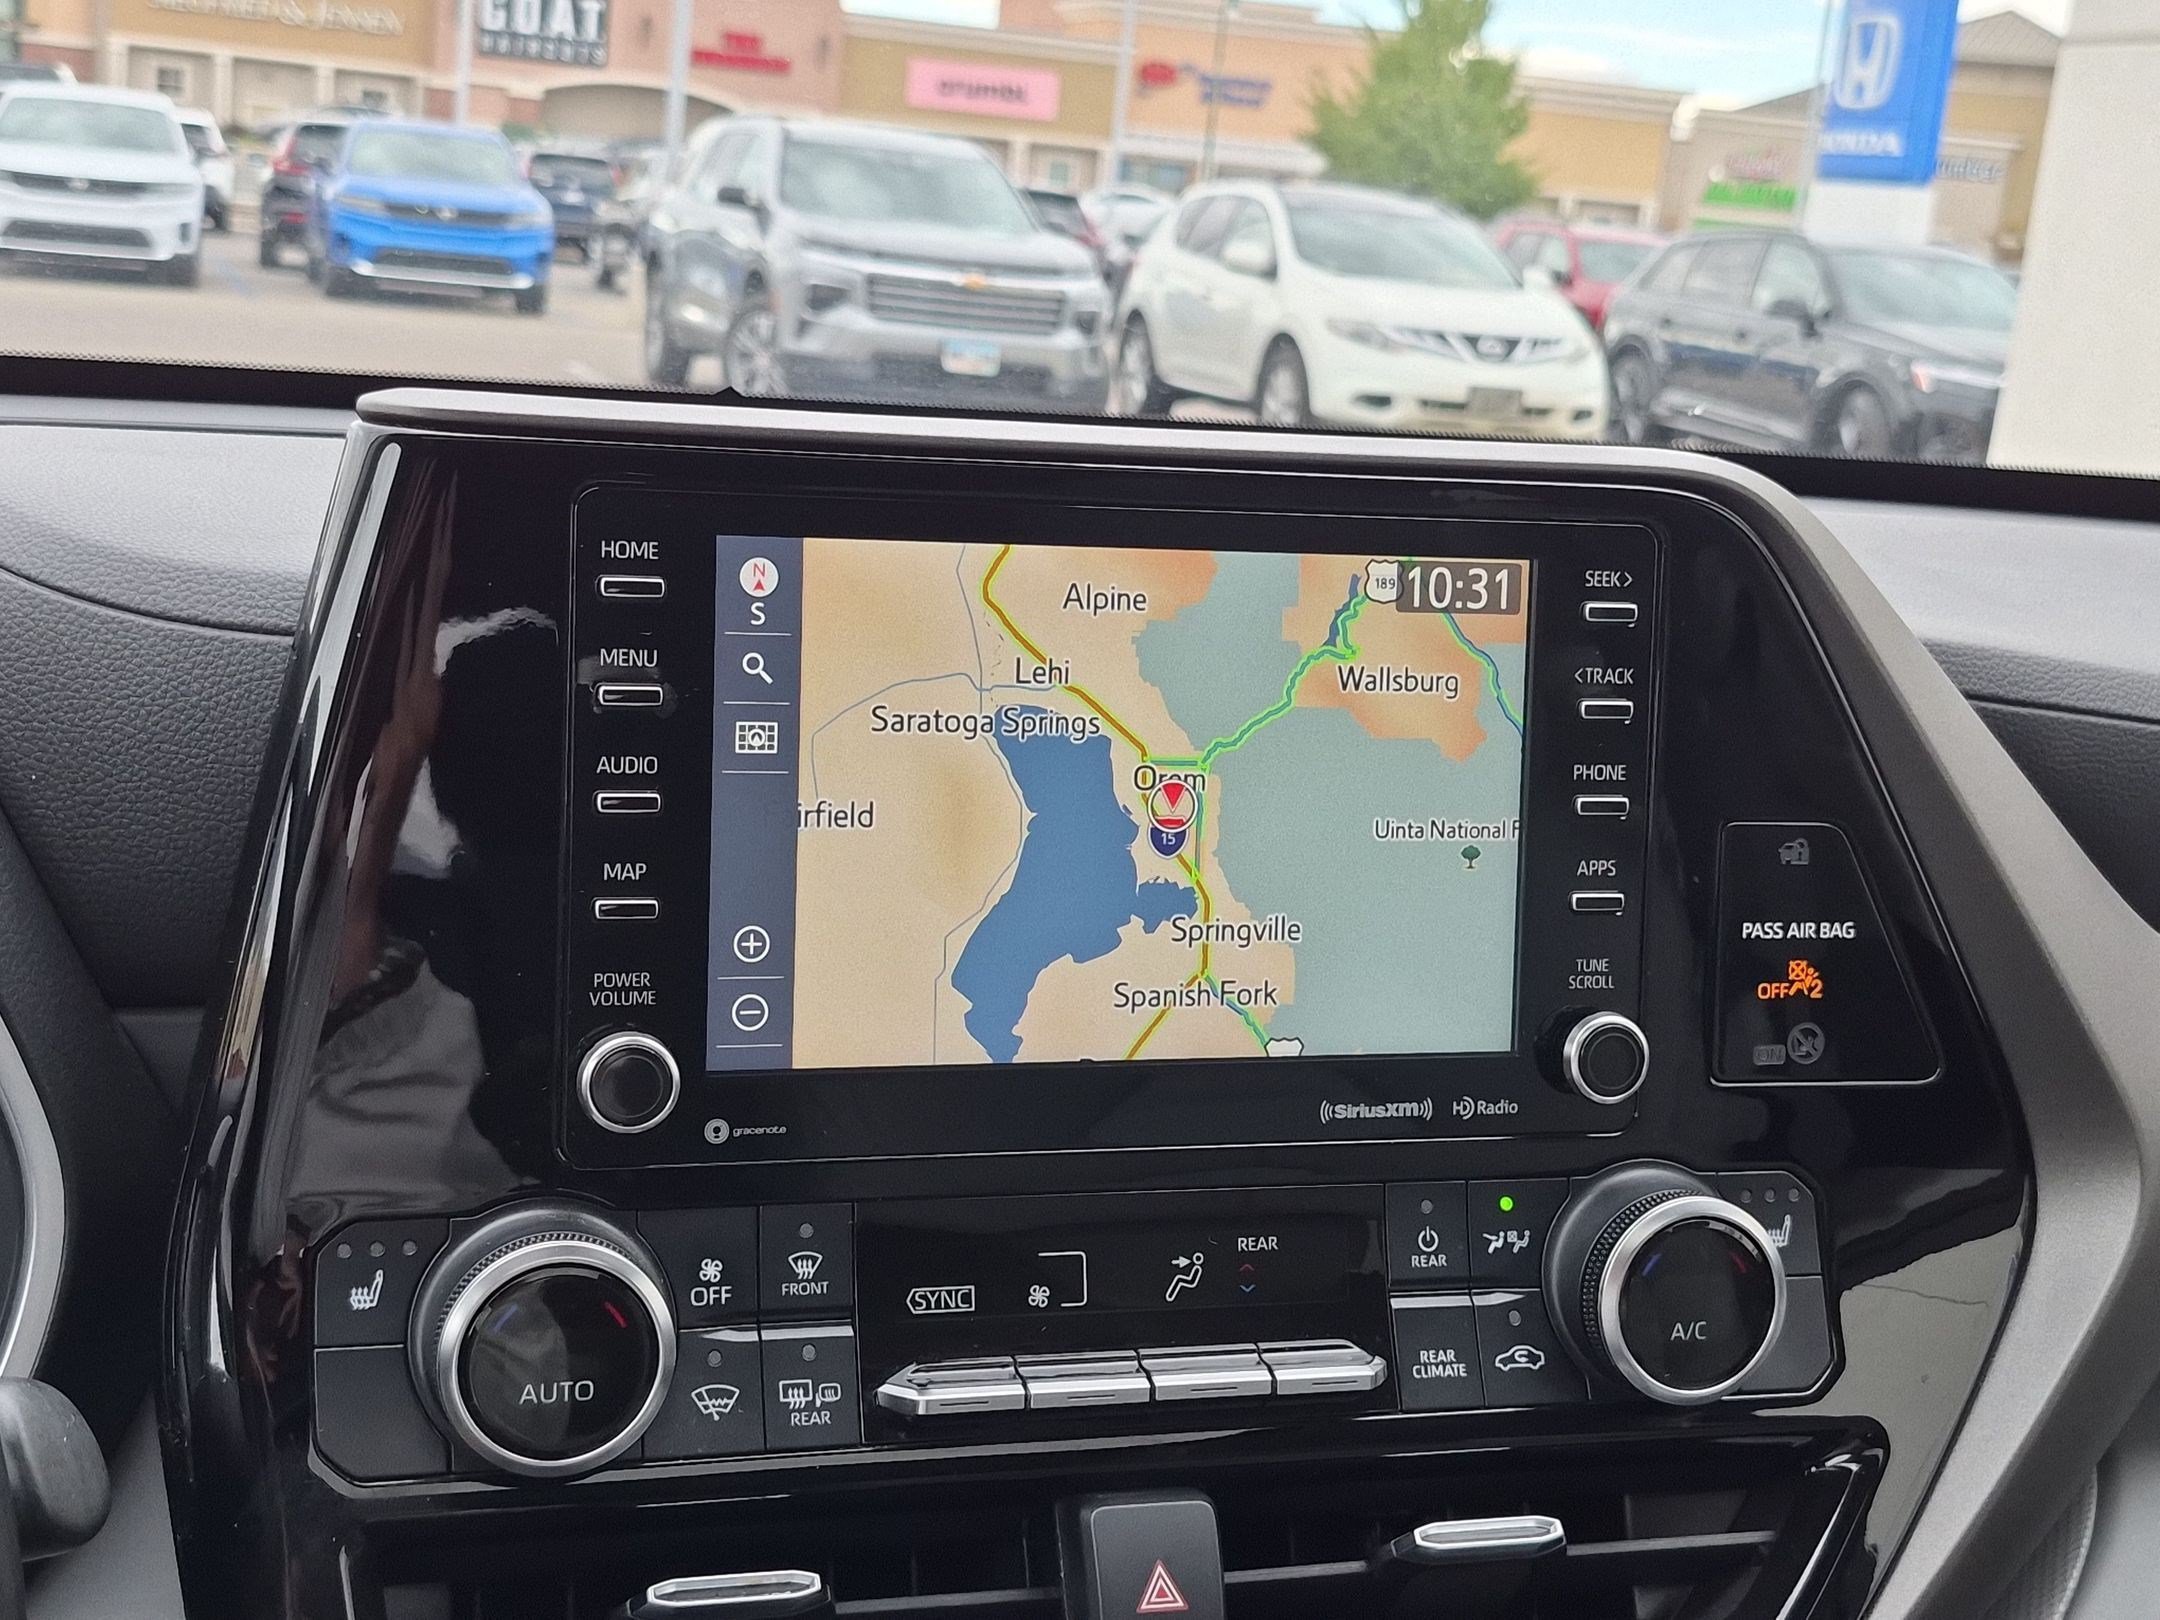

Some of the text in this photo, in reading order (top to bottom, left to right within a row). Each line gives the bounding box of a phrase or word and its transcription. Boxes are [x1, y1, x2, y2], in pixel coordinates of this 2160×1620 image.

[601, 540, 659, 560] HOME
[1375, 578, 1396, 590] 189
[1408, 566, 1509, 611] 10:31
[1062, 583, 1148, 616] Alpine
[750, 602, 766, 625] S
[600, 648, 658, 668] MENU
[1015, 657, 1070, 685] Lehi
[1337, 665, 1459, 699] Wallsburg
[871, 705, 1101, 743] Saratoga Springs
[596, 756, 658, 774] AUDIO
[1573, 764, 1627, 782] PHONE
[1375, 819, 1424, 839] Uinta
[1430, 819, 1506, 839] National
[1161, 833, 1176, 845] 15
[603, 864, 647, 881] MAP
[1577, 860, 1616, 877] APPS
[1172, 916, 1302, 948] Springville
[1742, 922, 1857, 939] PASS AIR BAG
[1576, 959, 1609, 973] TUNE
[594, 973, 651, 988] POWER
[1568, 976, 1615, 990] SCROLL
[589, 990, 657, 1006] VOLUME
[1114, 980, 1278, 1013] Spanish Fork
[1757, 982, 1789, 999] OFF
[1477, 1099, 1519, 1115] Radio
[733, 1126, 787, 1137] gracenote
[1237, 1236, 1278, 1251] REAR
[1411, 1255, 1447, 1268] REAR
[690, 1286, 732, 1306] OFF
[781, 1281, 829, 1296] FRONT
[913, 1291, 971, 1309] SYNC
[1670, 1321, 1707, 1341] A/C
[1419, 1350, 1456, 1363] REAR
[1412, 1363, 1467, 1378] CLIMATE
[519, 1380, 595, 1405] AUTO
[791, 1411, 832, 1427] REAR
